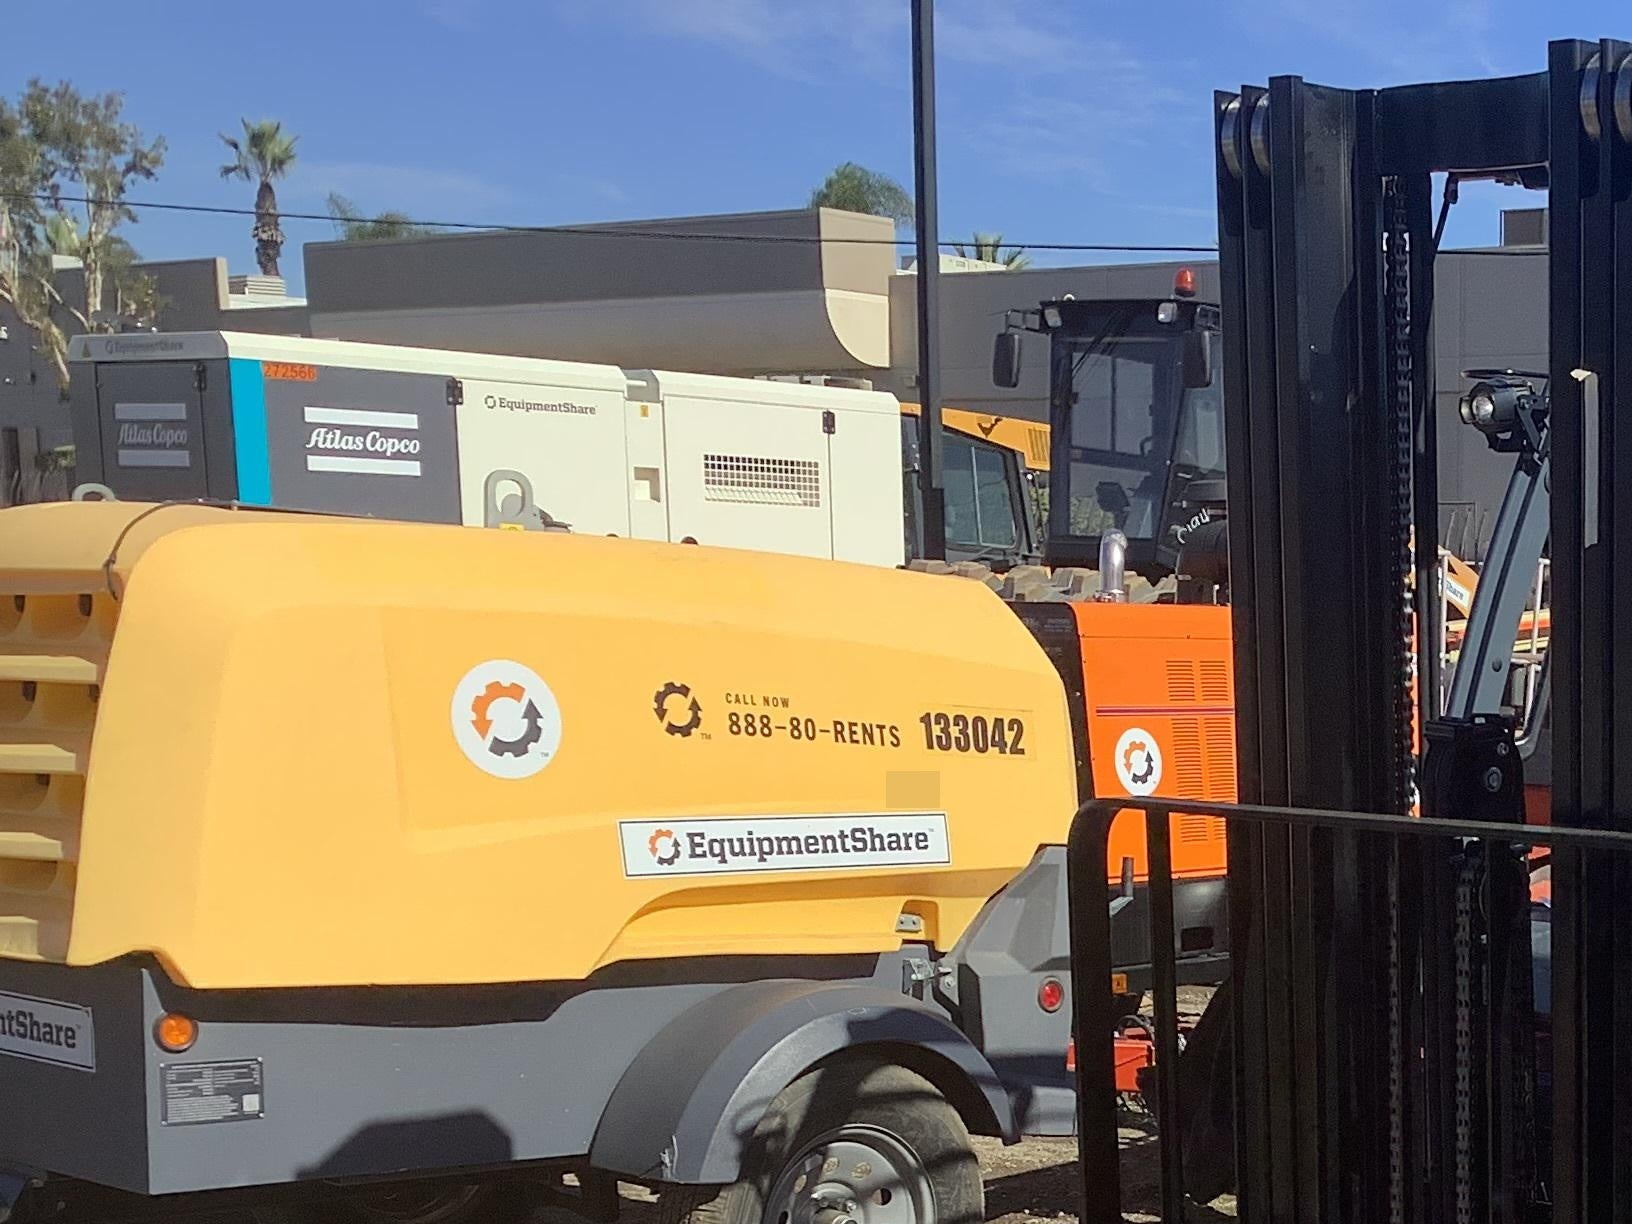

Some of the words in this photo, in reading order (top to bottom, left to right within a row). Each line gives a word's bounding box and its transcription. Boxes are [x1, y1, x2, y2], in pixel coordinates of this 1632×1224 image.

[498, 397, 597, 415] EquipmentShare
[117, 423, 150, 446] Atlas
[153, 424, 188, 449] Copco
[305, 427, 363, 450] Atlas
[365, 430, 420, 456] Copco
[725, 692, 757, 706] CALL
[763, 695, 790, 709] NOW
[727, 711, 901, 748] 888-80-RENTS
[919, 710, 1027, 756] 133042
[686, 826, 930, 865] EquipmentShare
